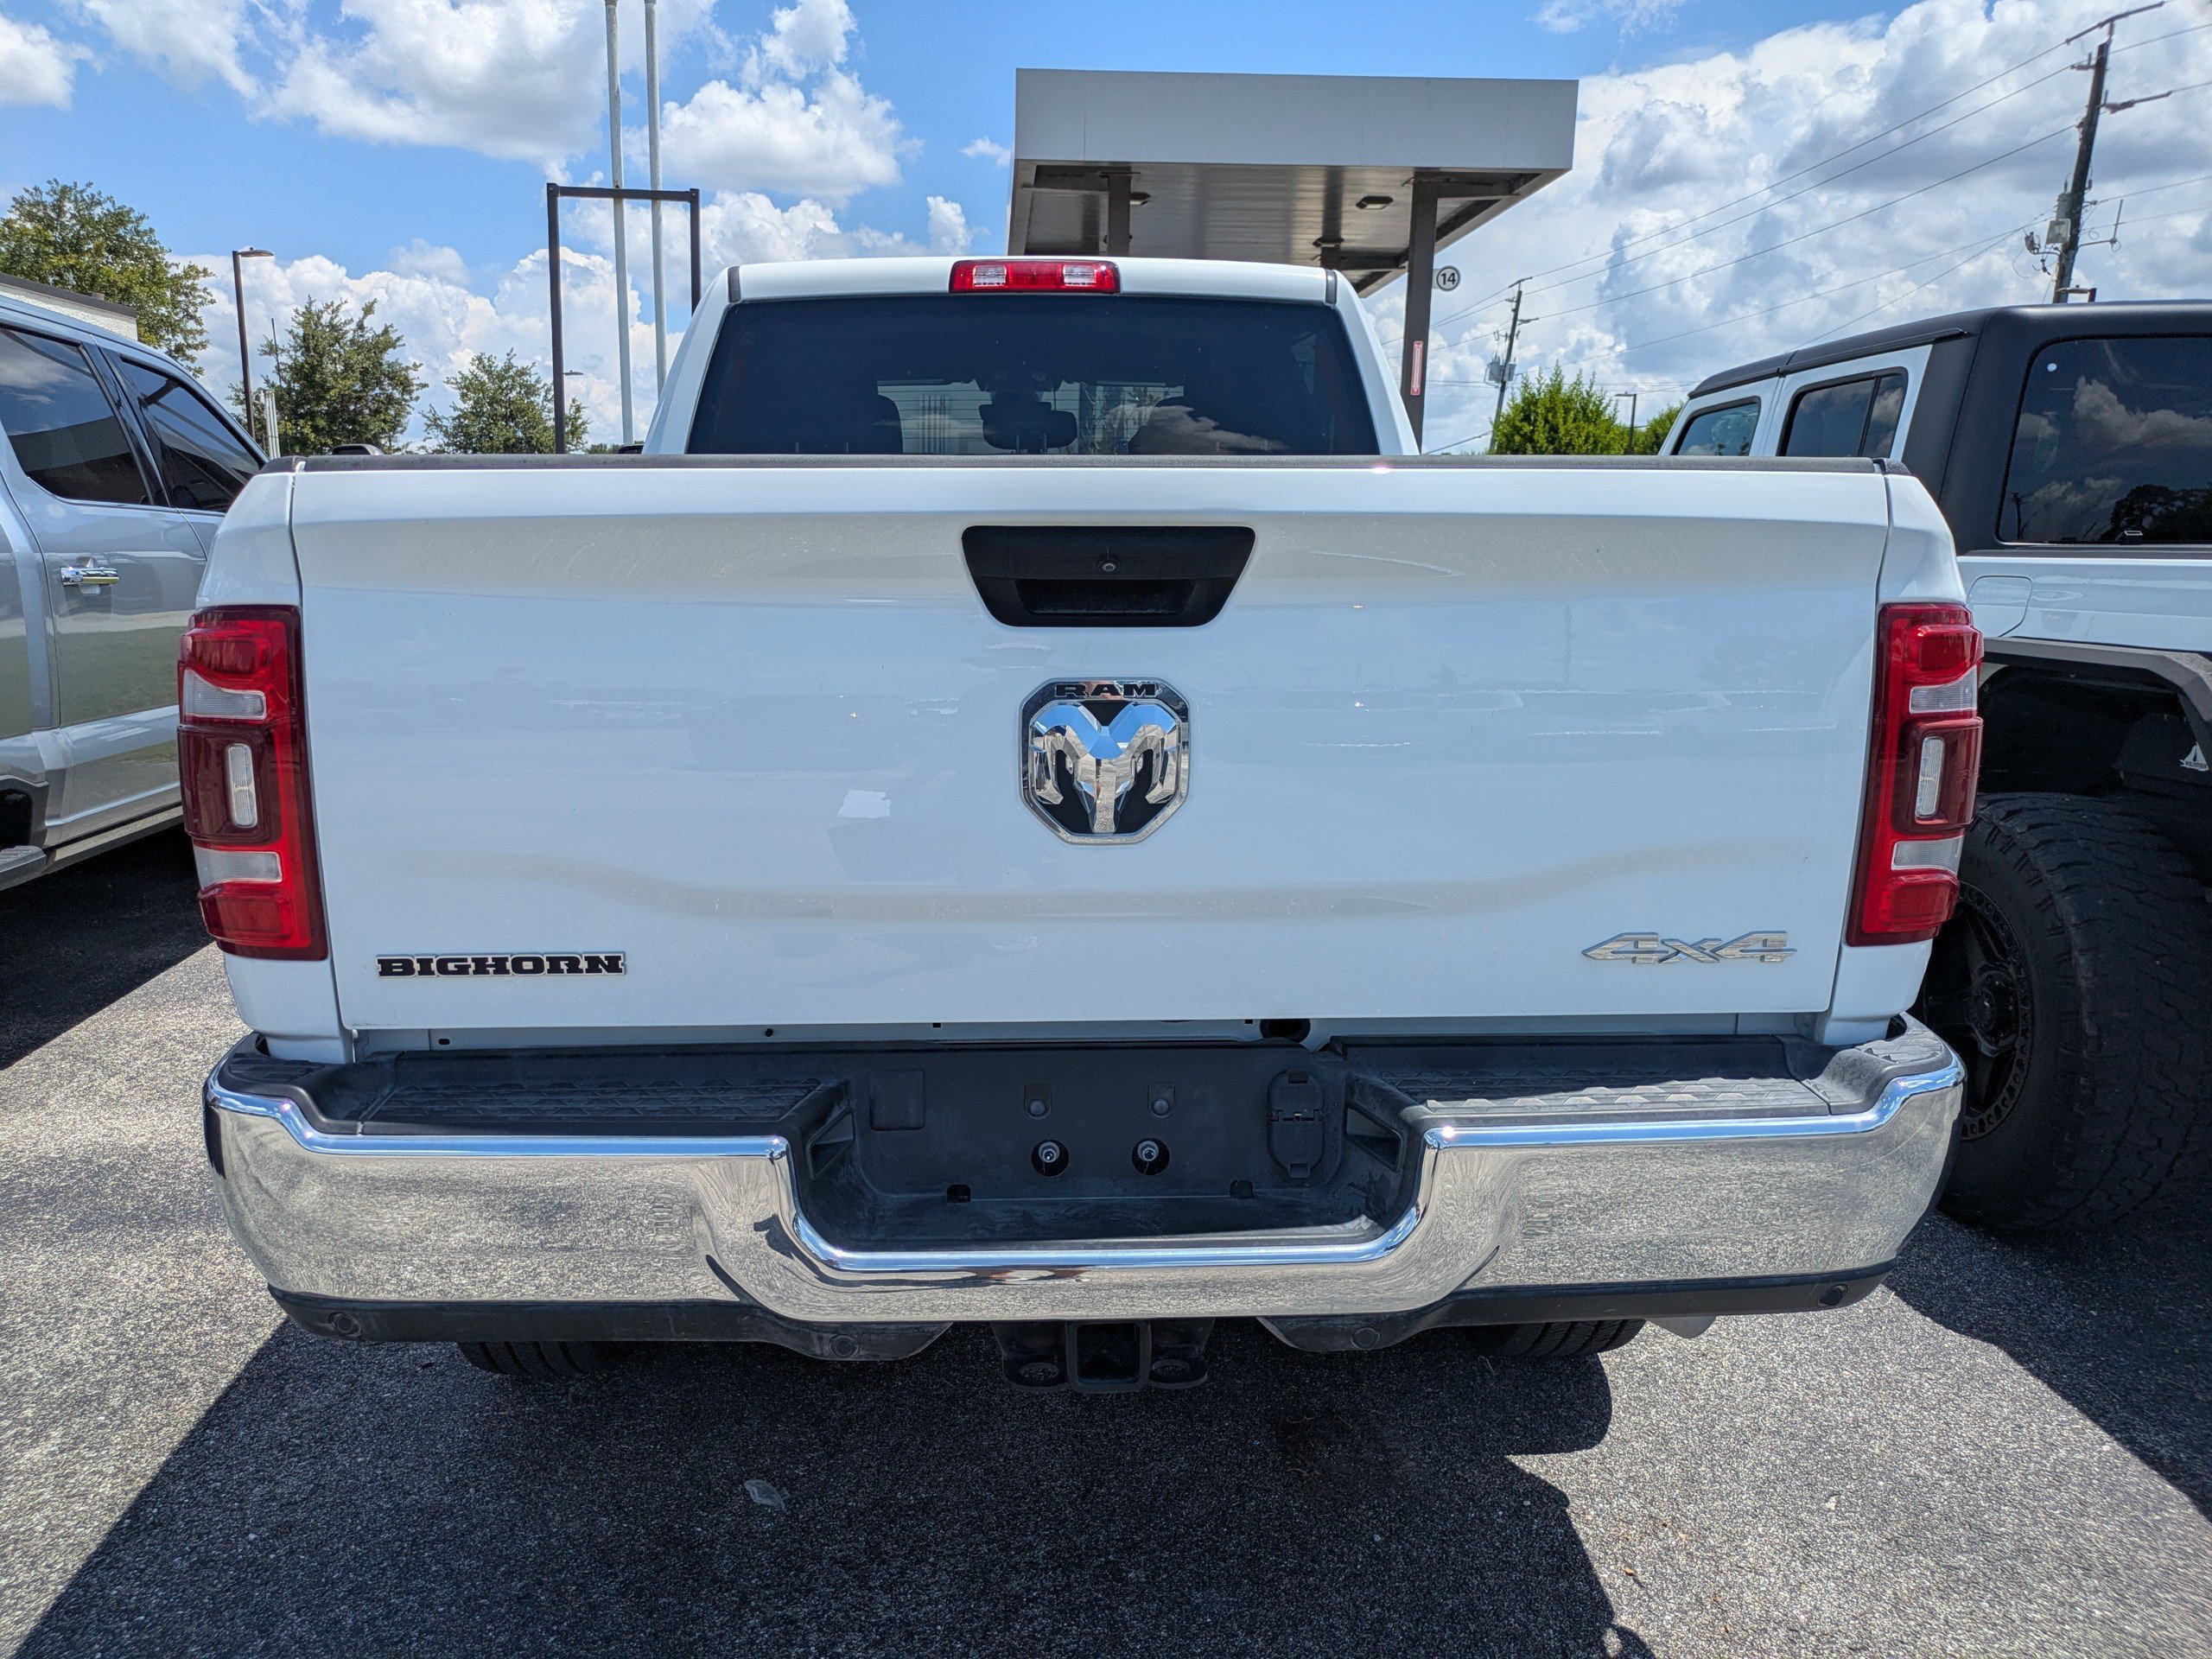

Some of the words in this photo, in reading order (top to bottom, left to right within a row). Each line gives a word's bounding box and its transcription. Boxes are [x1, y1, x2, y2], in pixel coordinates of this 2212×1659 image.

[1440, 272, 1457, 285] 14
[1054, 683, 1159, 698] RAM
[375, 951, 626, 977] BIGHORN
